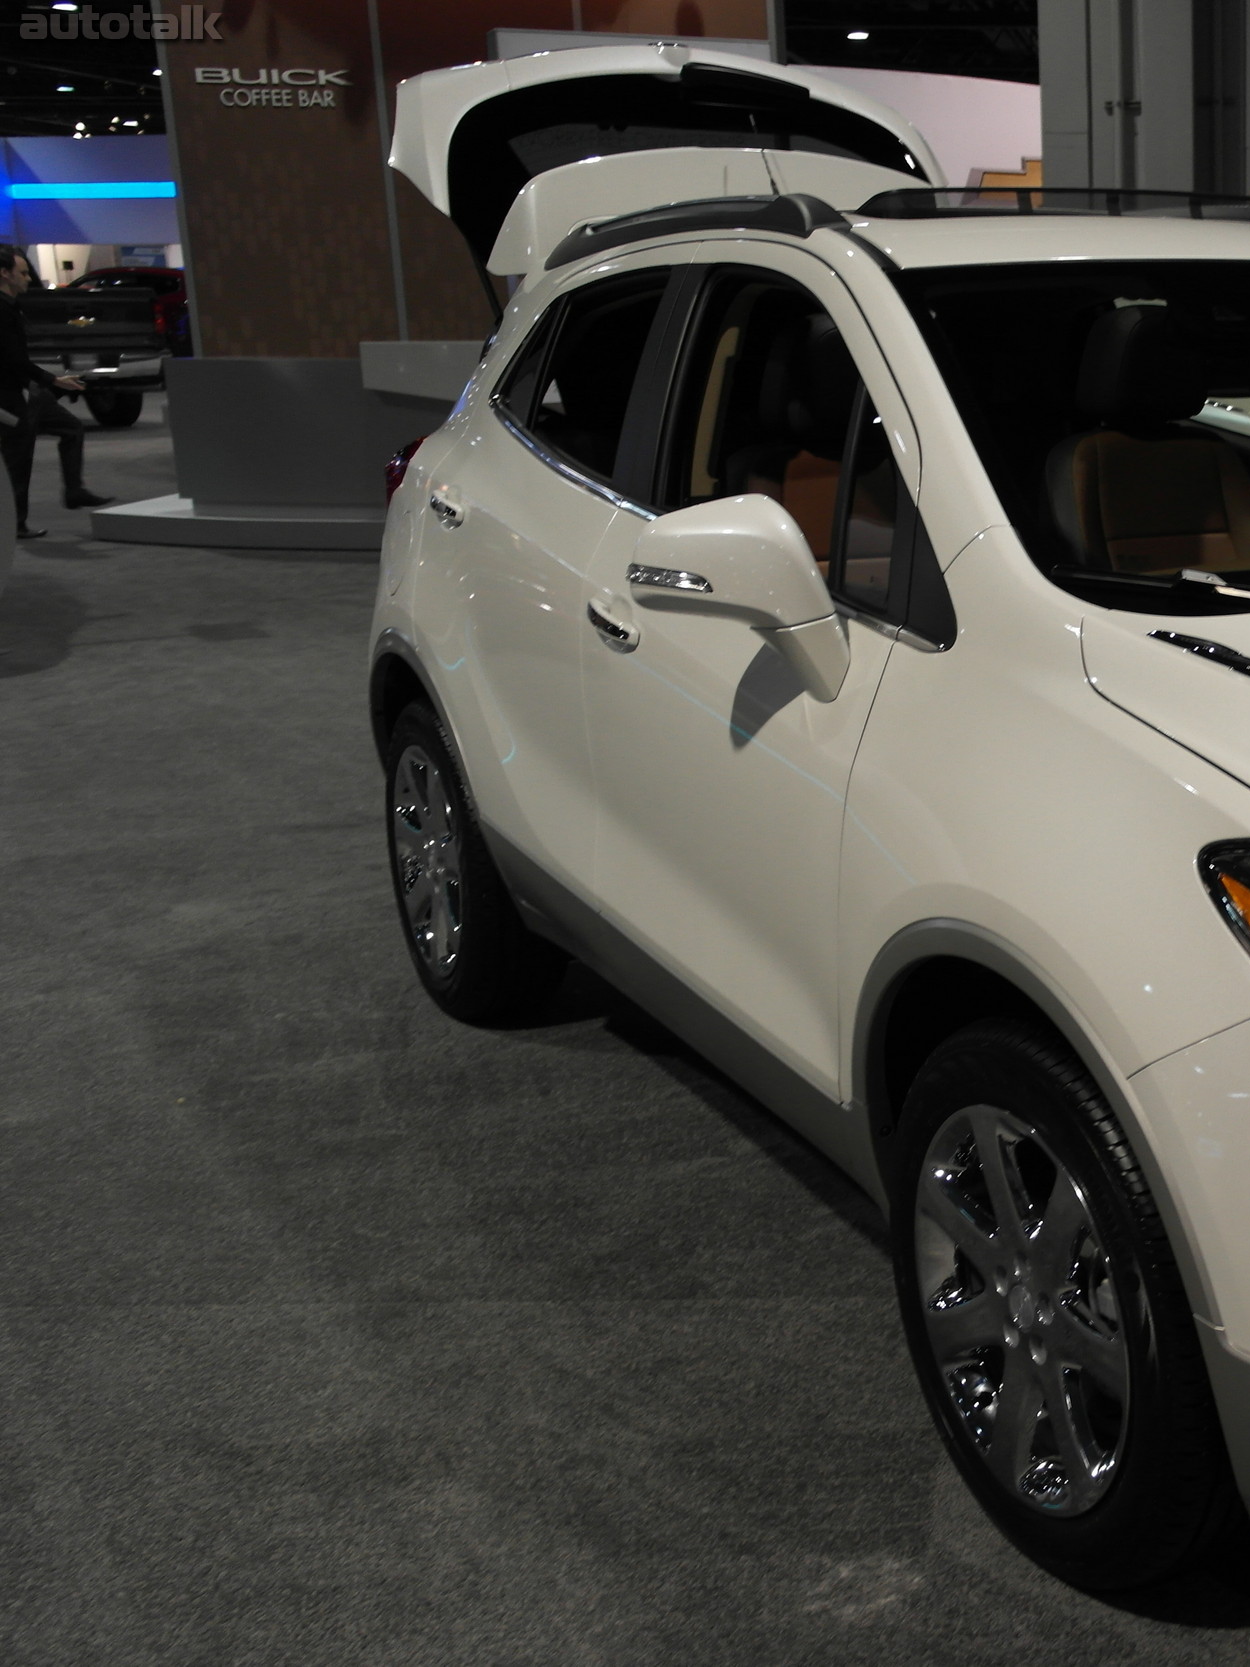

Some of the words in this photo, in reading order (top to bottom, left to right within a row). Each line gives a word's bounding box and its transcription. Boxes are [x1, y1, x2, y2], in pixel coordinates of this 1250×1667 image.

[194, 67, 351, 86] BUICK
[219, 88, 292, 108] COFFEE
[298, 89, 337, 108] BAR
